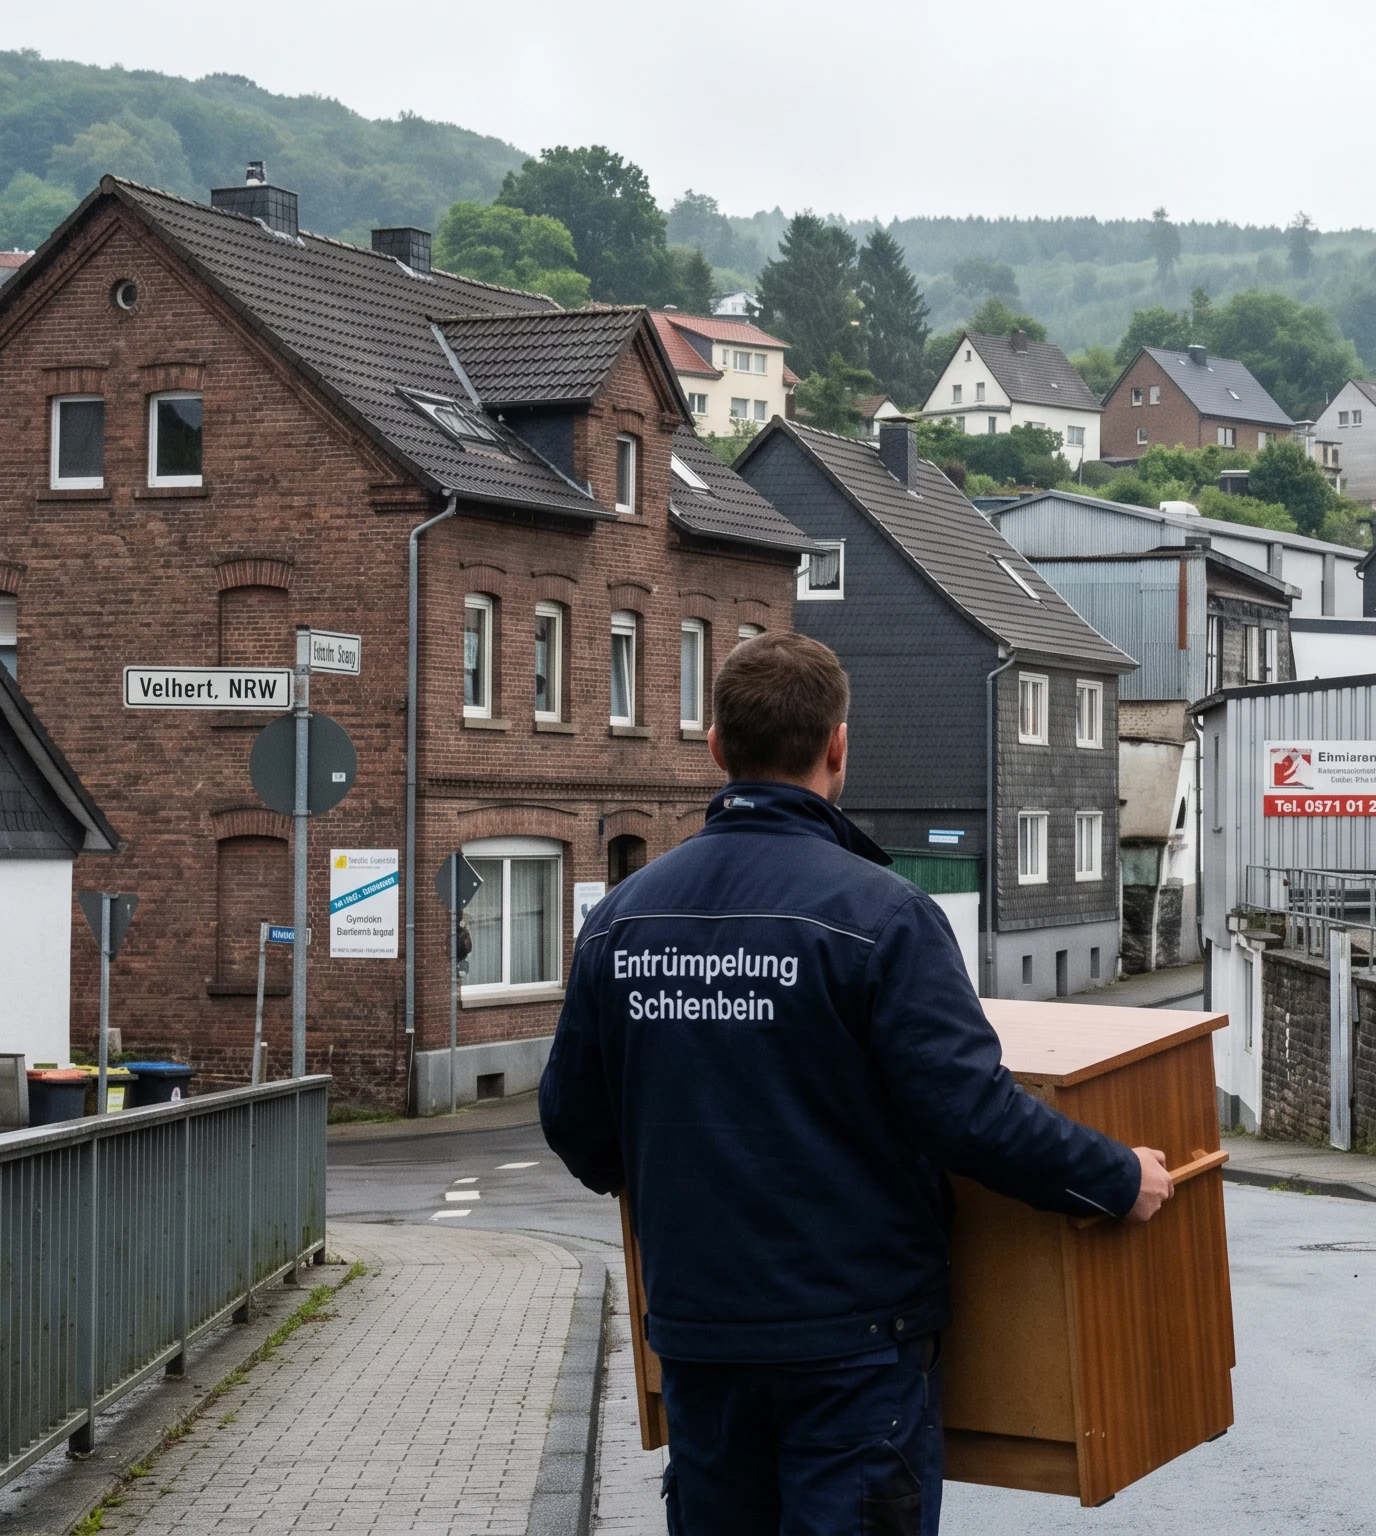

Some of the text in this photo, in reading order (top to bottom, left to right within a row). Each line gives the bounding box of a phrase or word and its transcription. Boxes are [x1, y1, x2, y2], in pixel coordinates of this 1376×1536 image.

[140, 677, 277, 700] Velhert, NRW
[1275, 800, 1301, 812] Tel.
[1346, 800, 1363, 812] 01
[614, 946, 799, 987] Entrümpelung
[628, 990, 775, 1021] Schienbein
